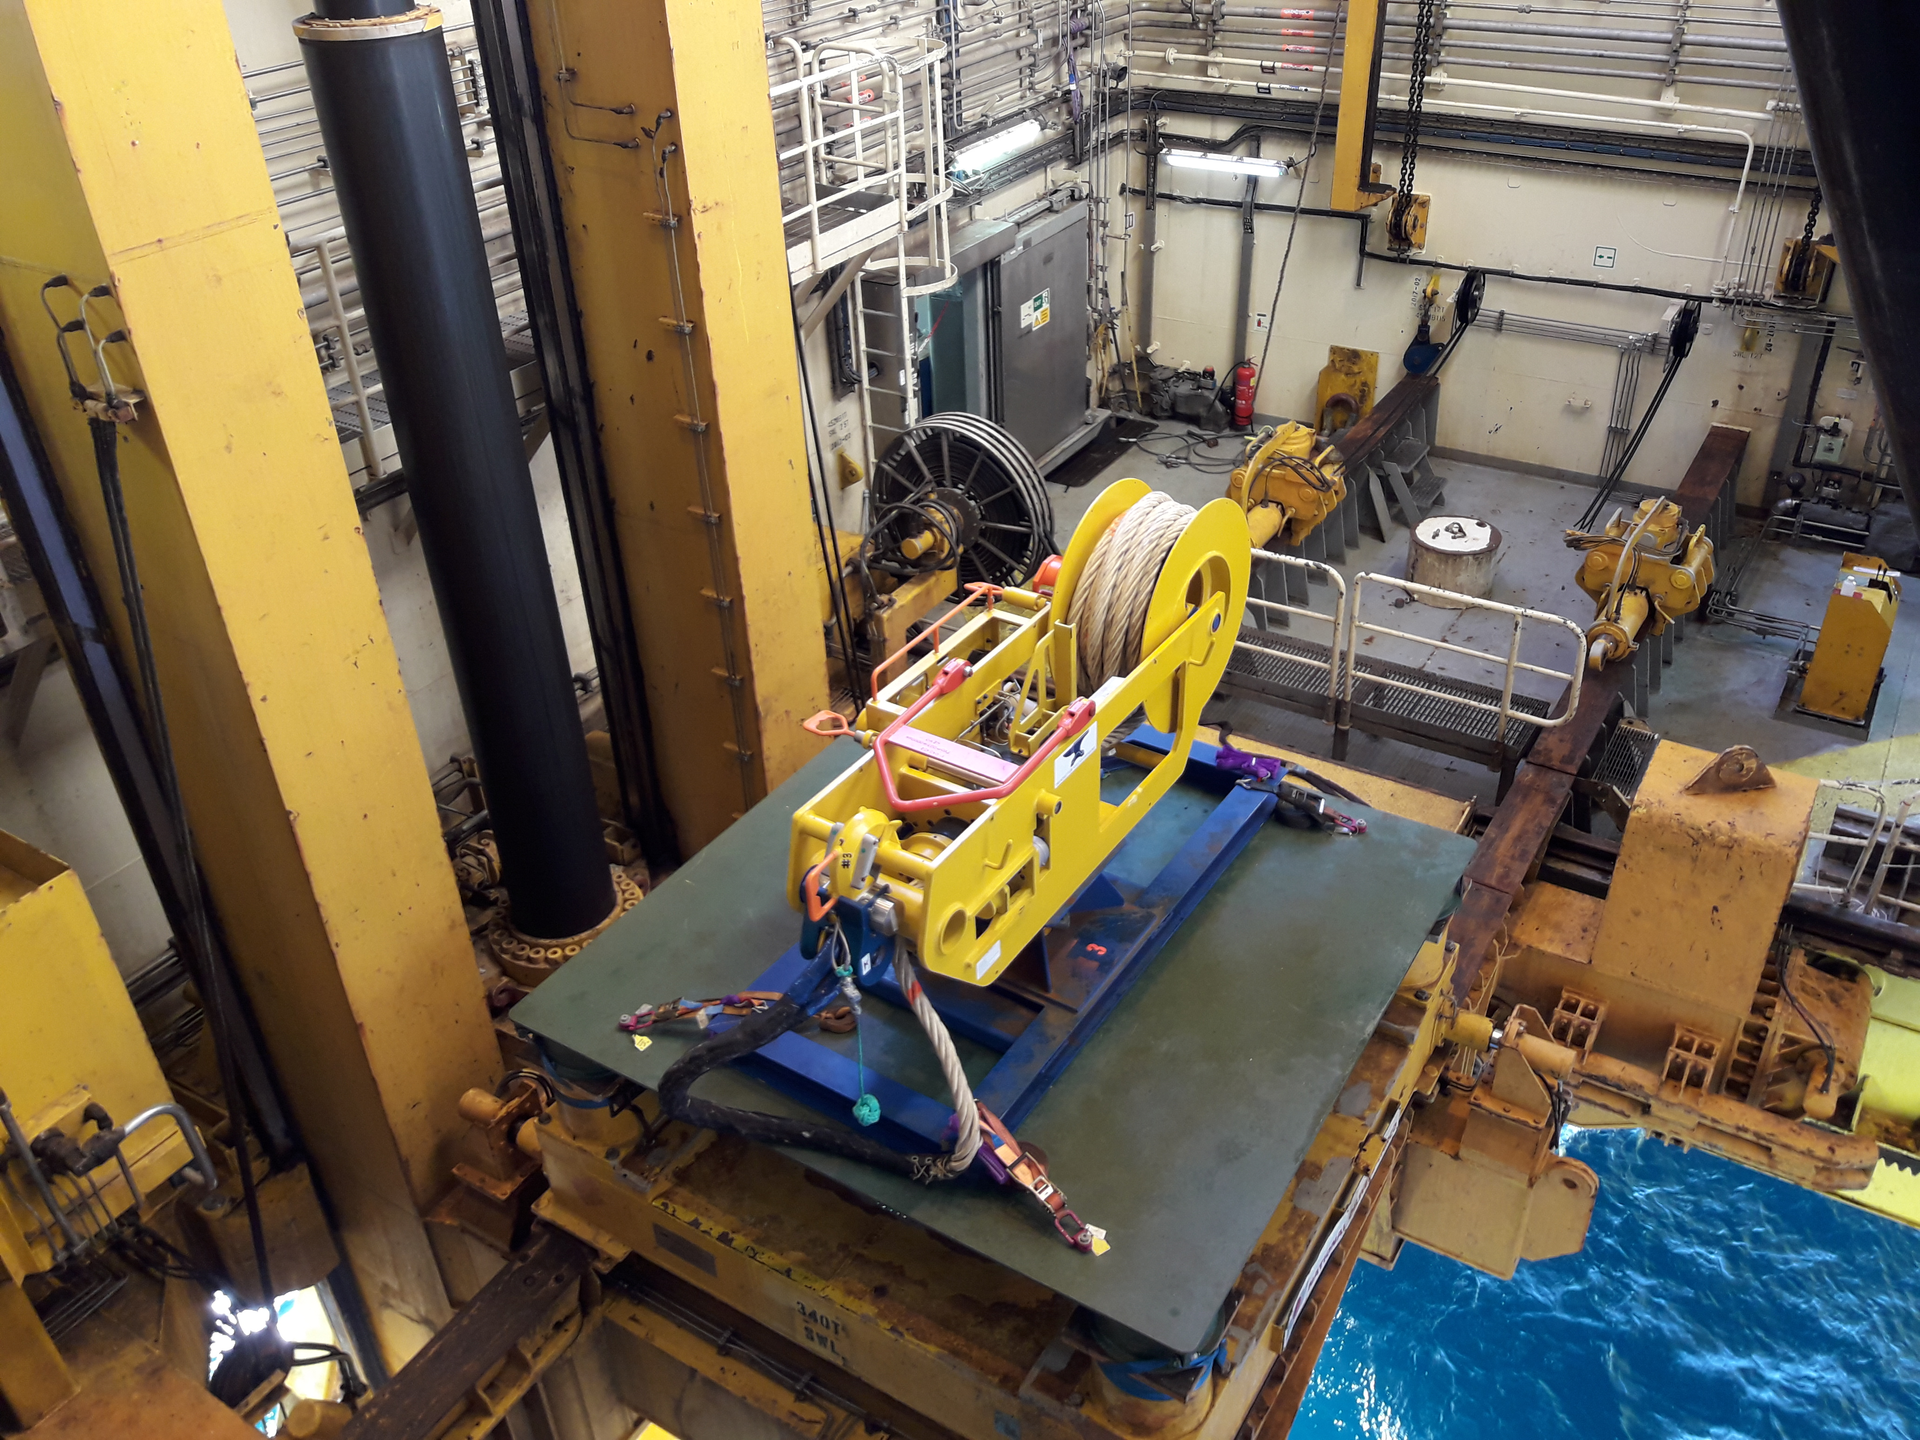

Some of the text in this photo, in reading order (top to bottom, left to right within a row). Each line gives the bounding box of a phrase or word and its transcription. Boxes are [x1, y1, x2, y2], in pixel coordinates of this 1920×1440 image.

[1411, 277, 1421, 307] 2017-02
[841, 853, 852, 869] #3
[1086, 943, 1107, 956] 3
[803, 1325, 841, 1357] SWL
